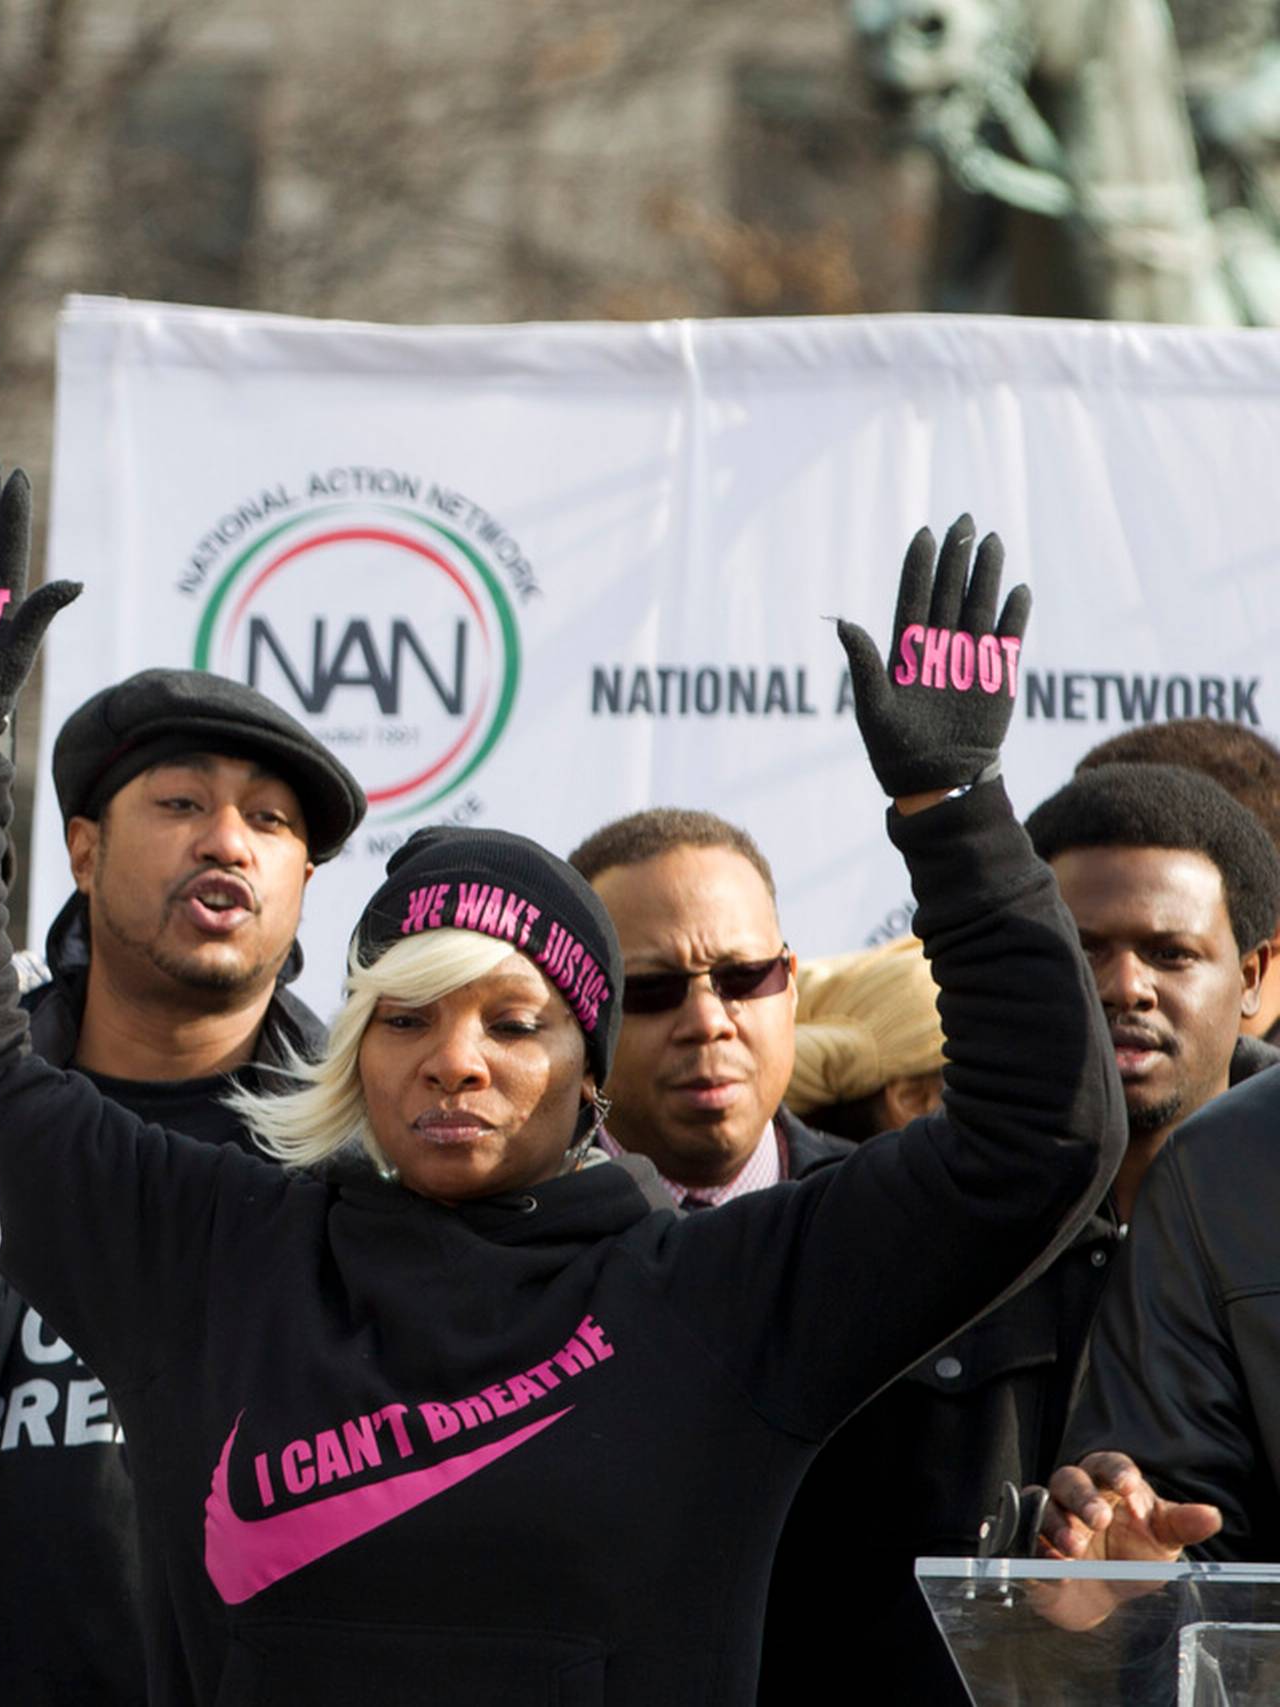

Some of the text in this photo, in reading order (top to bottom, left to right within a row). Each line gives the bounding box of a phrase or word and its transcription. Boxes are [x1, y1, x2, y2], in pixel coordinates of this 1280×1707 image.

[177, 466, 544, 606] NATIONAL ACTION NETWORK
[247, 616, 468, 716] NAN
[591, 664, 820, 716] NATIONAL
[895, 623, 1020, 698] SHOOT
[1026, 669, 1261, 725] NETWORK
[401, 883, 451, 934] WE
[453, 882, 541, 949] WANT
[254, 1314, 615, 1507] I CAN'T BREATHE
